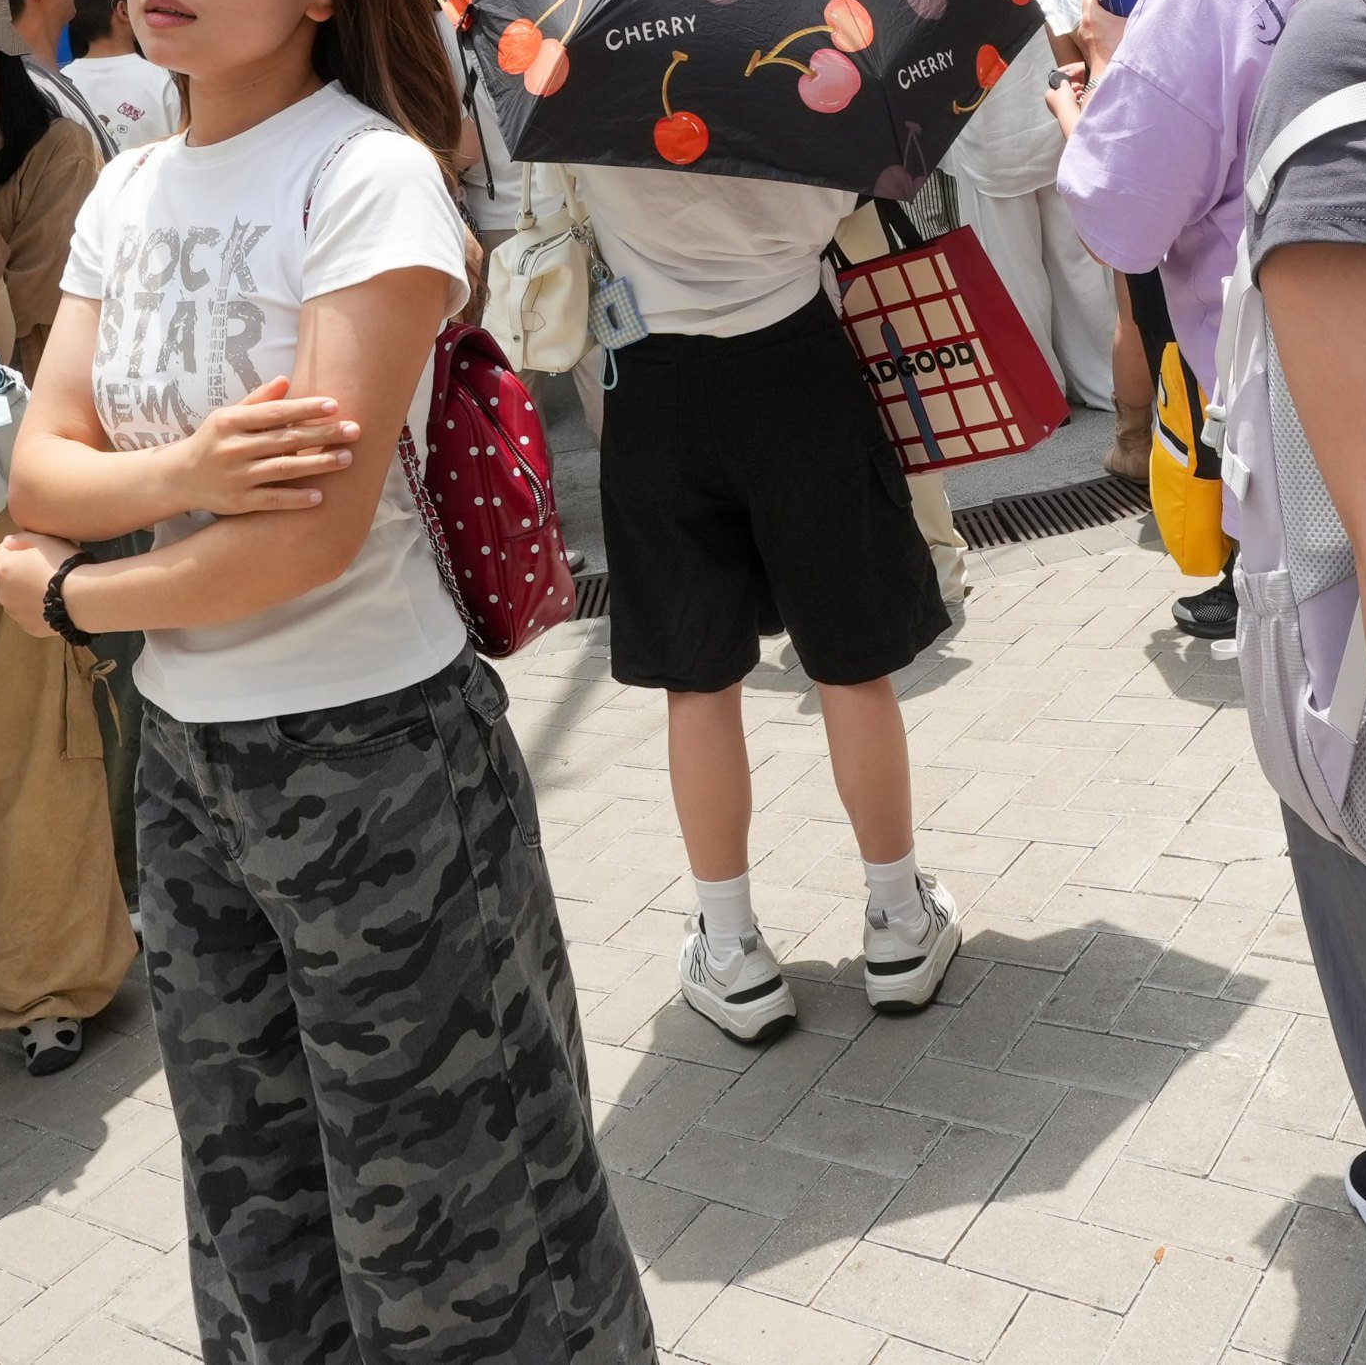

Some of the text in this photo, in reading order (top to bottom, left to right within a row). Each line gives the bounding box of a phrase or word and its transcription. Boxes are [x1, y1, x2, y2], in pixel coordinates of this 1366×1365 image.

[605, 14, 698, 51] CHERRY
[898, 49, 955, 90] CHERRY
[105, 215, 272, 300] ROCK
[95, 292, 267, 395] STAR
